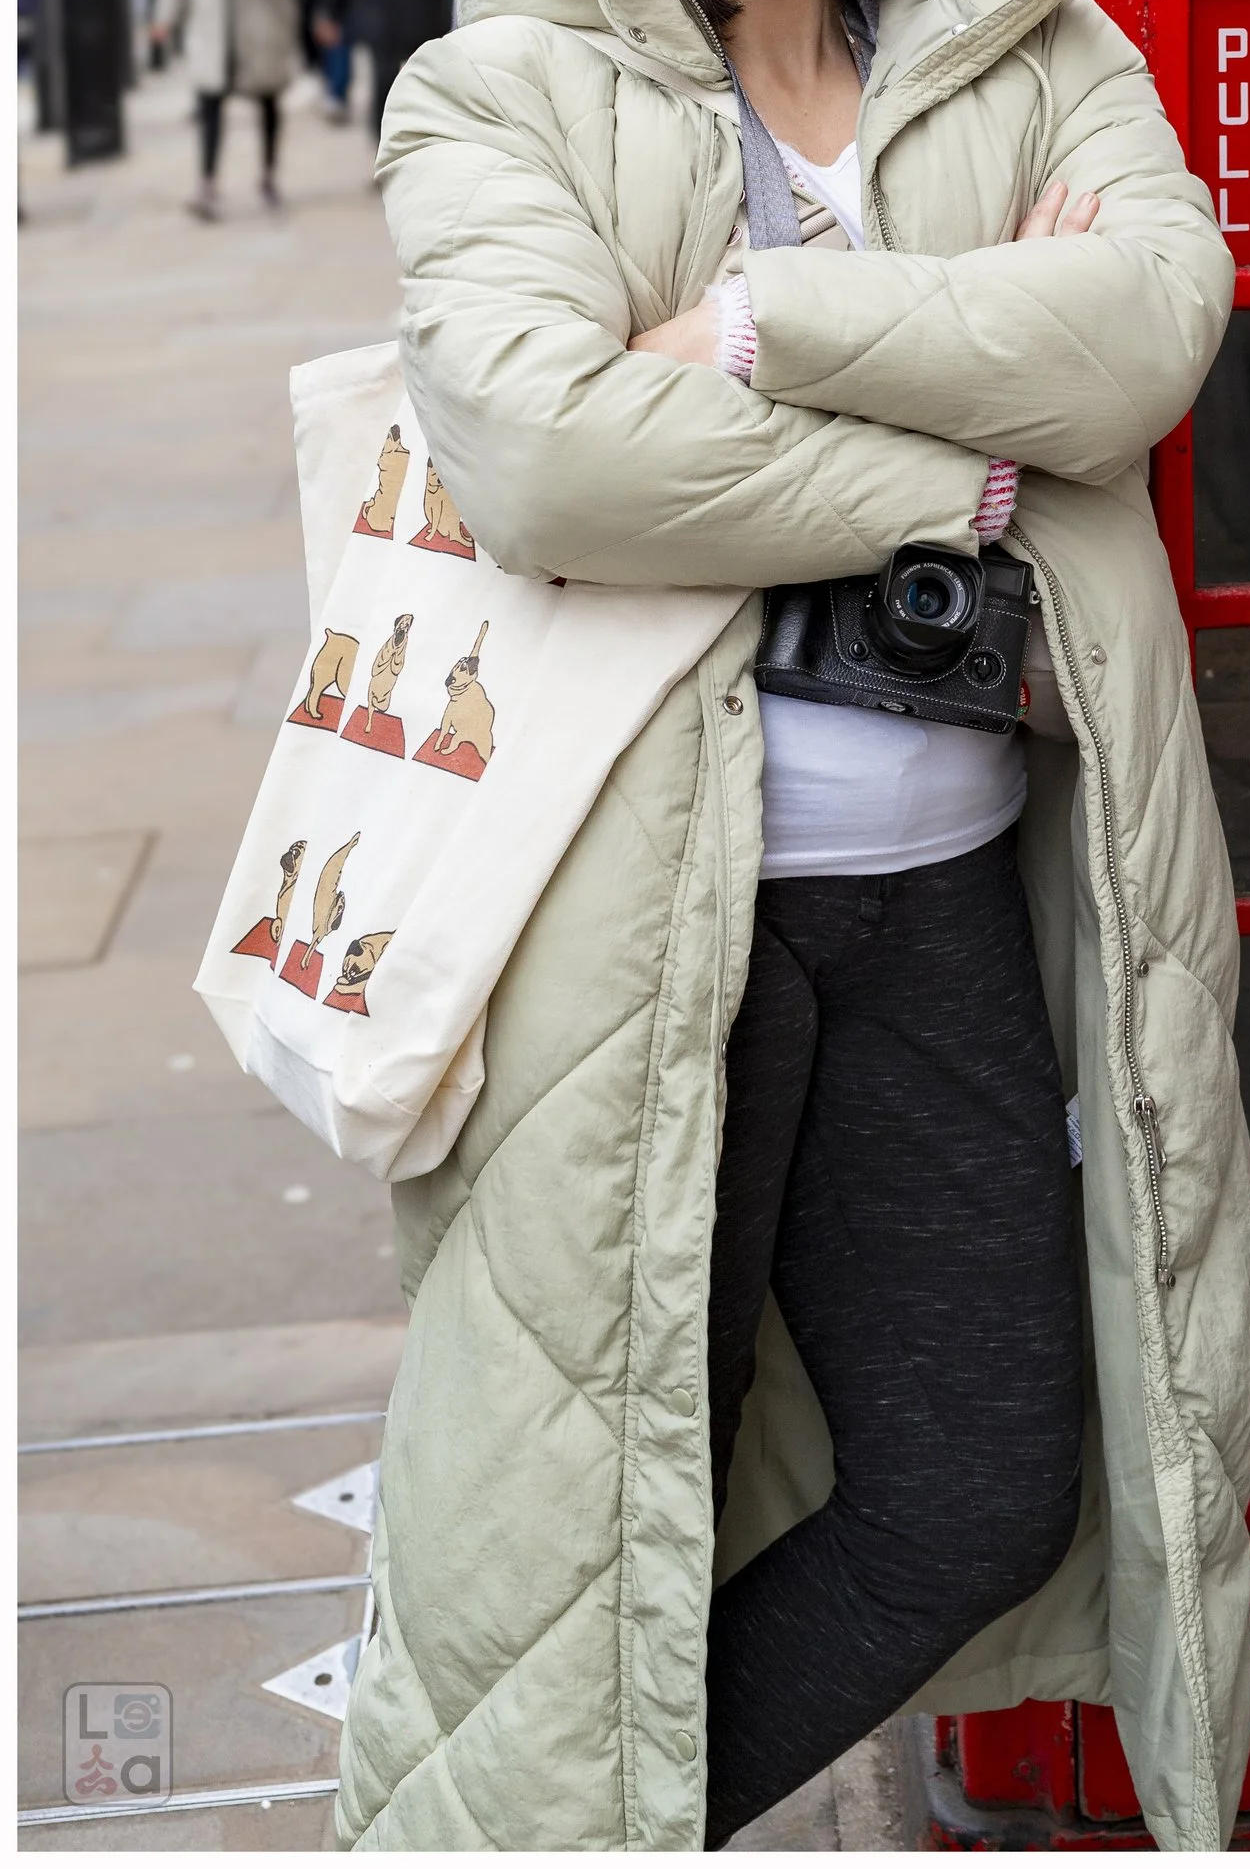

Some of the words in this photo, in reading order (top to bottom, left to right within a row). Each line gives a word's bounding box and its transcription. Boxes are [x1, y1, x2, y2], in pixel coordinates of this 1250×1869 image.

[1218, 27, 1250, 232] PULL
[901, 564, 921, 579] FUJINON
[923, 562, 954, 577] ASPHERICAL
[953, 577, 964, 591] LENS
